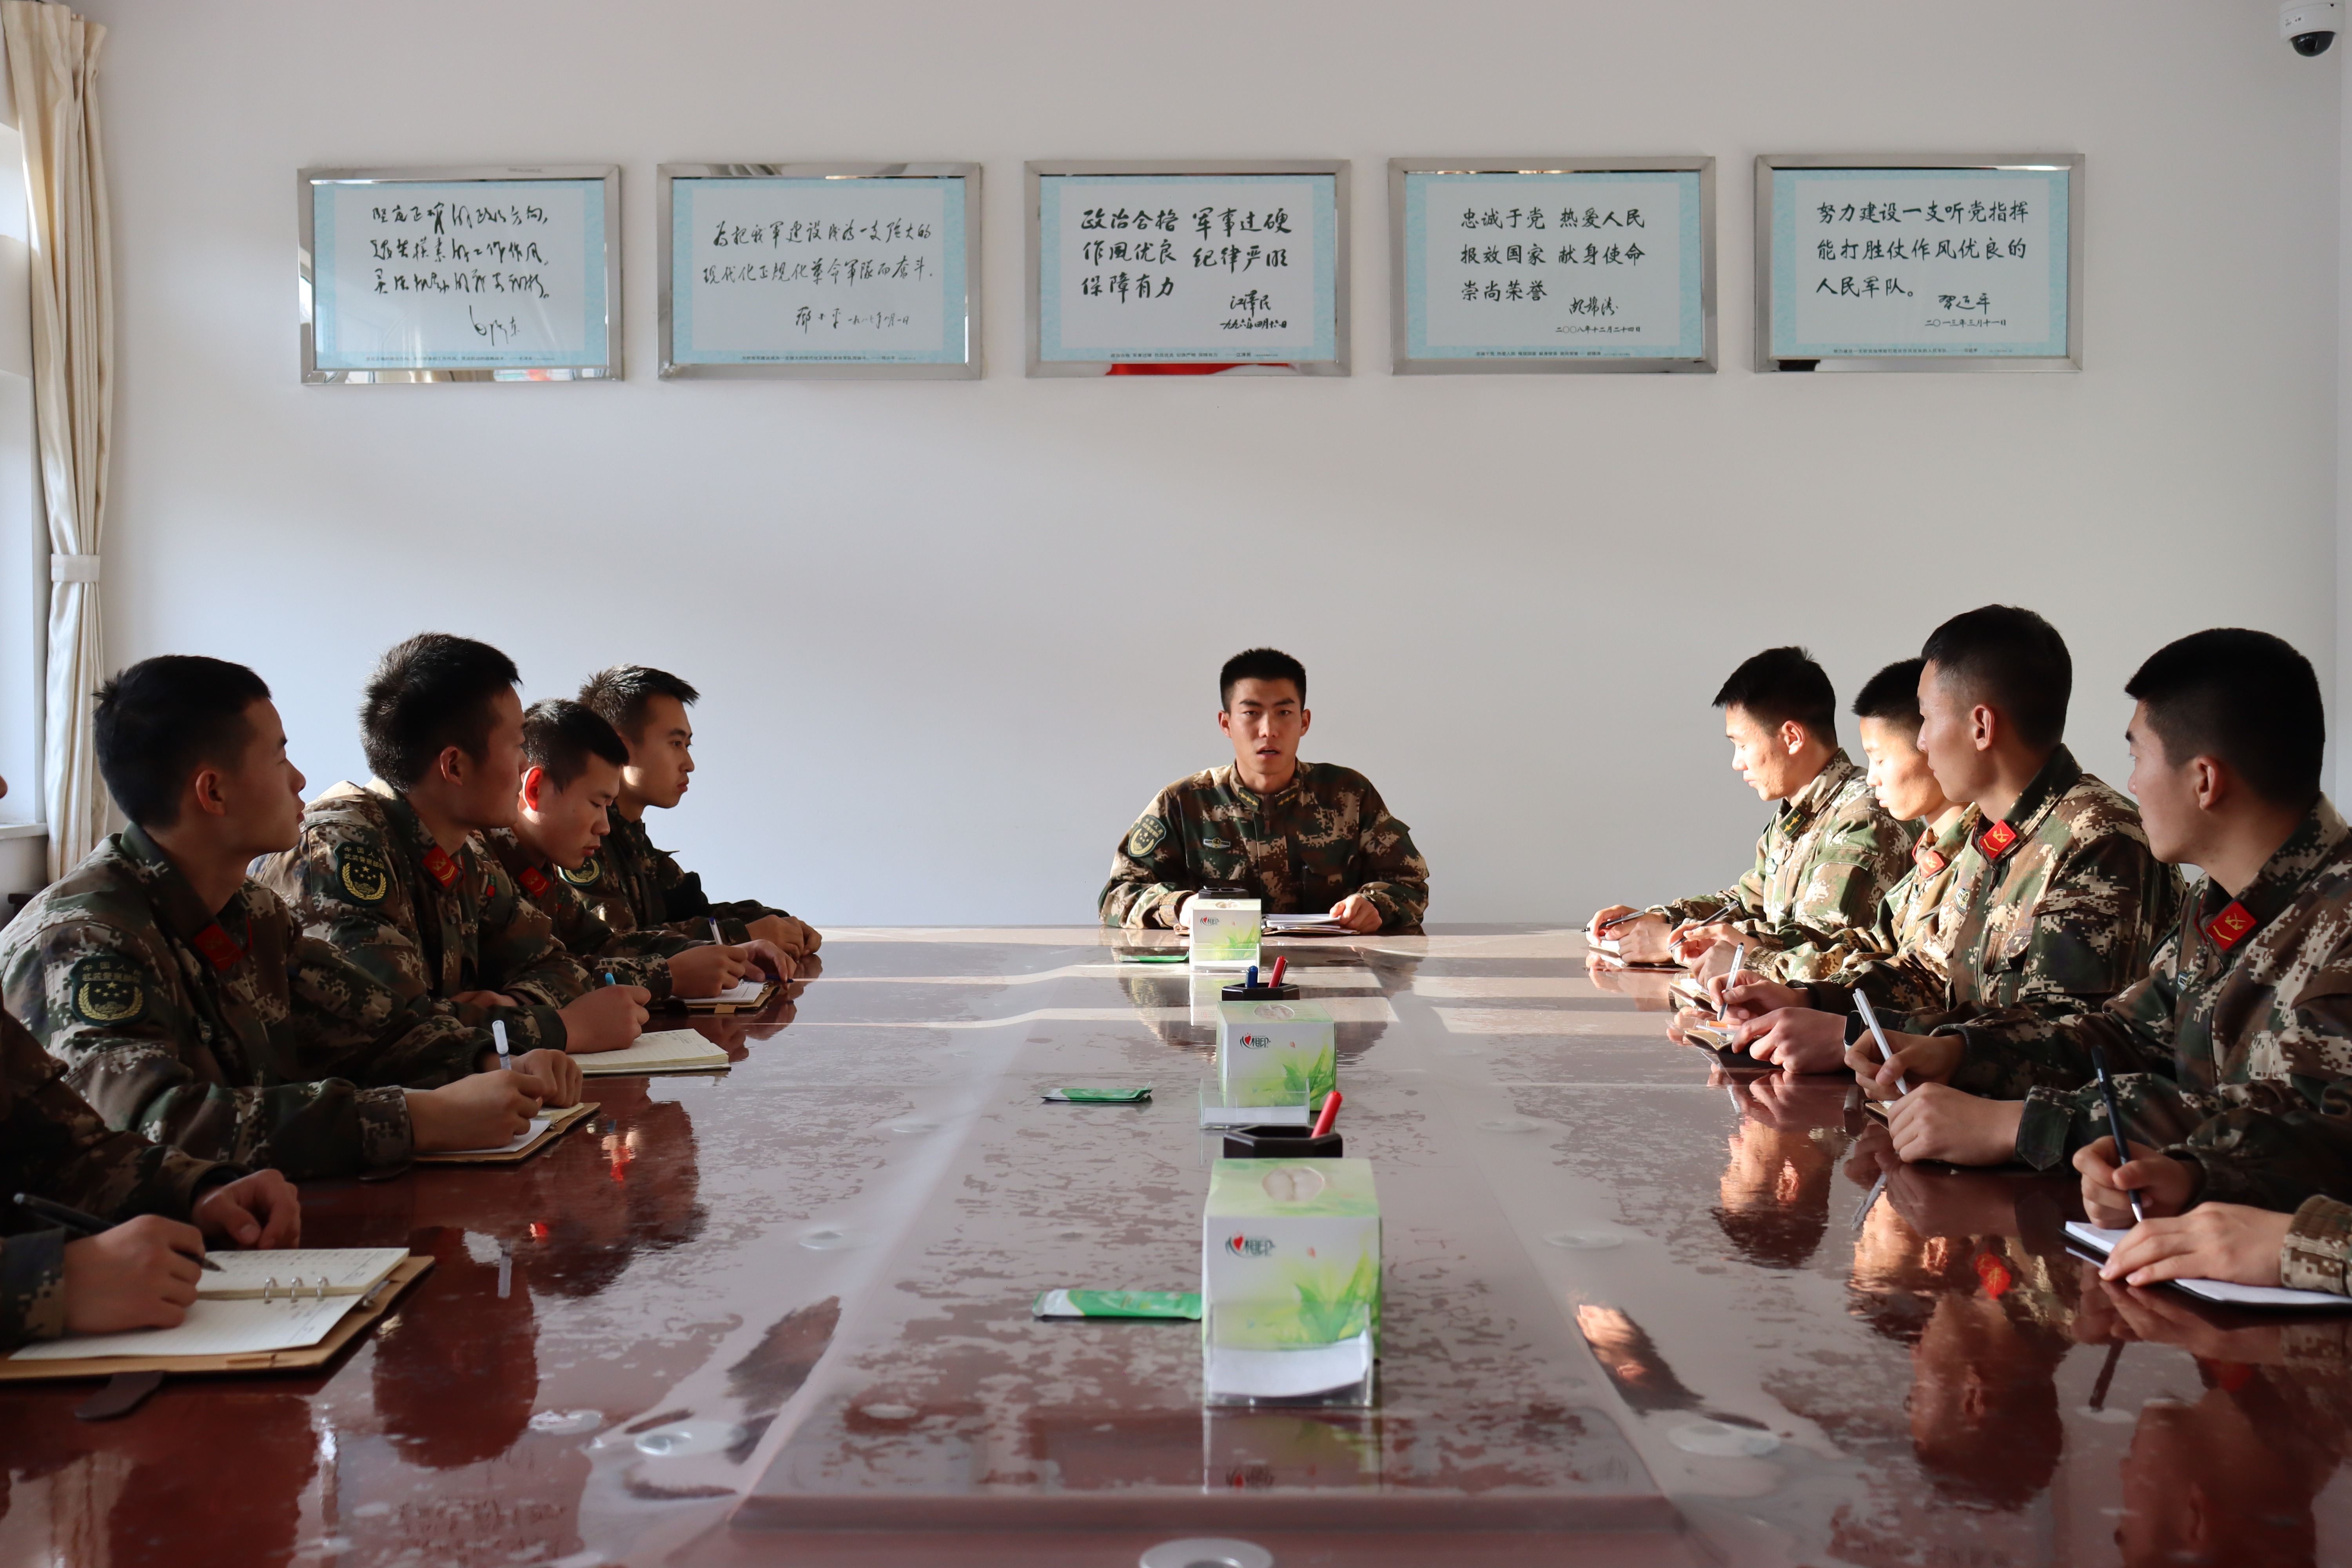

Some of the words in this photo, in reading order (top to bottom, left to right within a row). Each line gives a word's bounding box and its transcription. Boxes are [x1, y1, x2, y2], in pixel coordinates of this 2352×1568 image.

[1081, 207, 1179, 232] 政治合格
[1192, 207, 1292, 241] 军事过硬
[1461, 207, 1546, 230] 忠诚于党
[1559, 207, 1645, 229] 热爱人民
[1817, 200, 2029, 224] 努力建设一支听党指挥
[1192, 244, 1288, 274] 纪律严明
[1460, 243, 1546, 266] 报效国家
[1558, 242, 1646, 266] 献身使命
[1817, 236, 2027, 261] 能打胜仗作风优良的
[1081, 272, 1174, 304] 保障有力
[1461, 279, 1548, 302] 崇尚荣誉
[1816, 276, 1913, 299] 人民军队。
